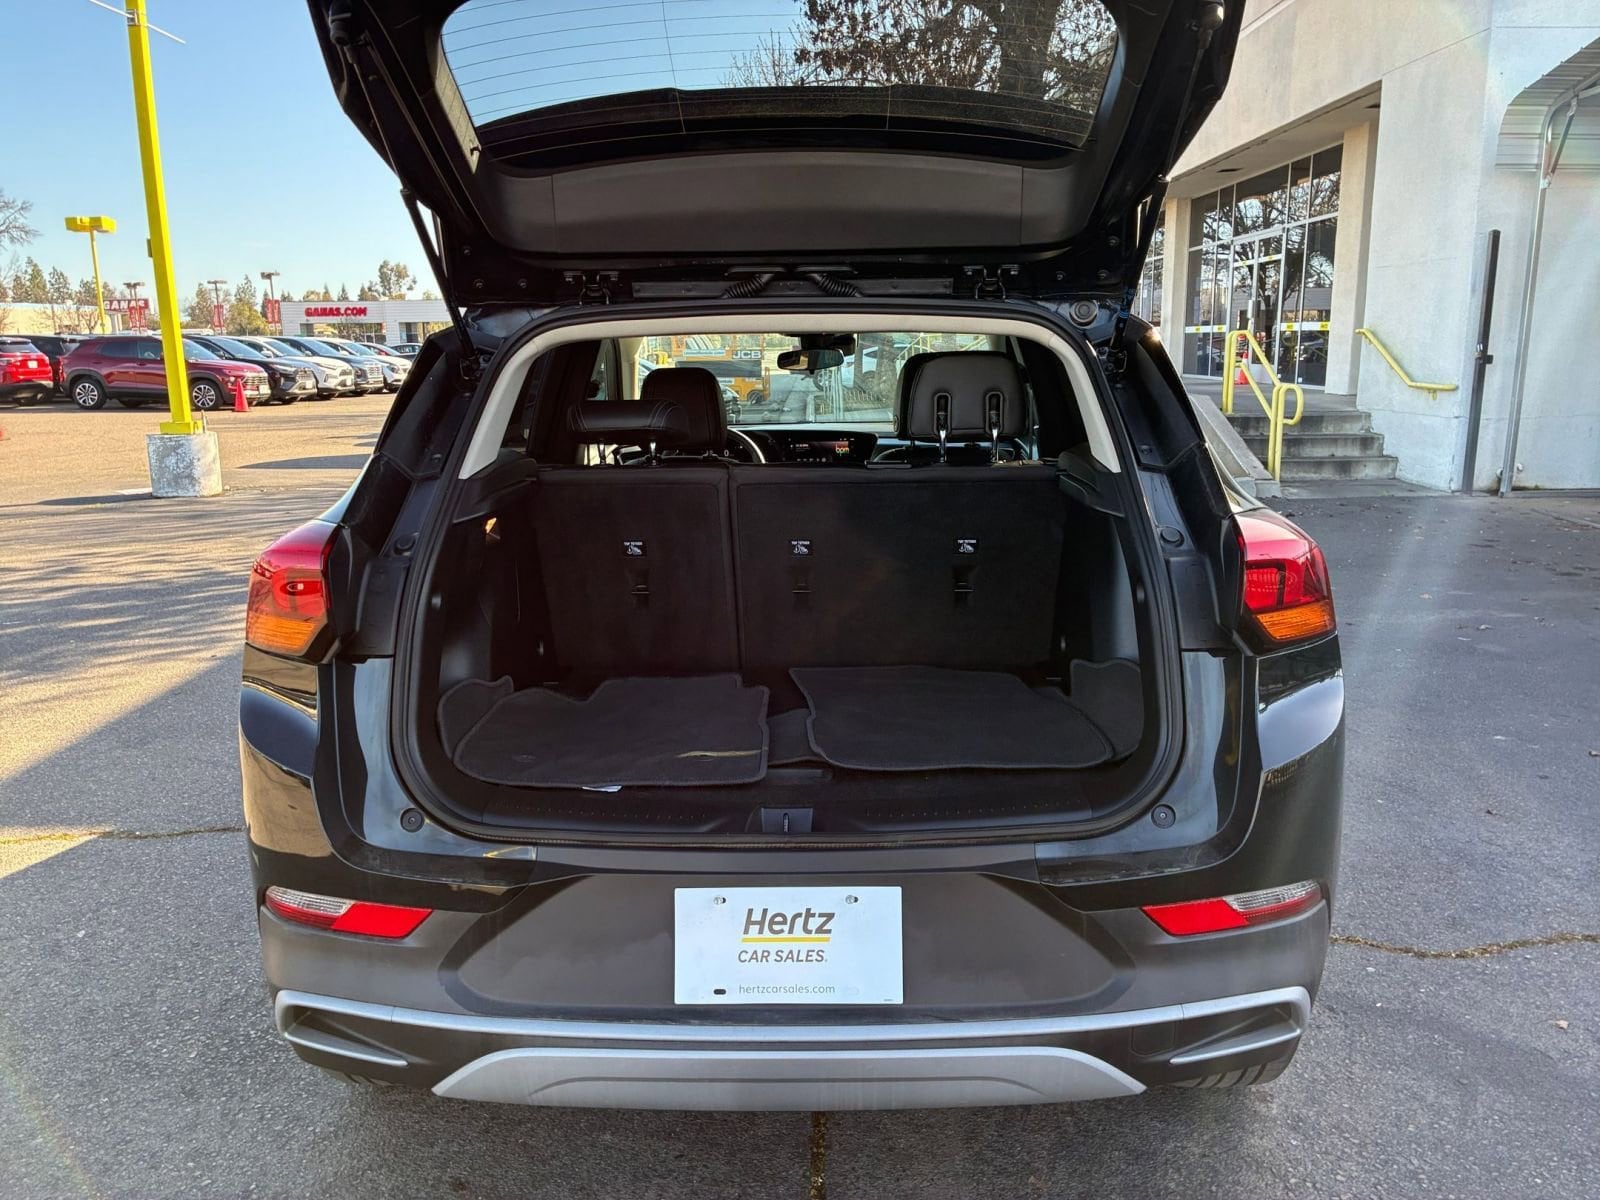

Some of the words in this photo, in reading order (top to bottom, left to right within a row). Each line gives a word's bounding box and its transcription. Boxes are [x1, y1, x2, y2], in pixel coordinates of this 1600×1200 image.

[743, 907, 835, 934] Hertz
[738, 949, 770, 963] CAR
[738, 984, 835, 994] hertzcarsales.com
